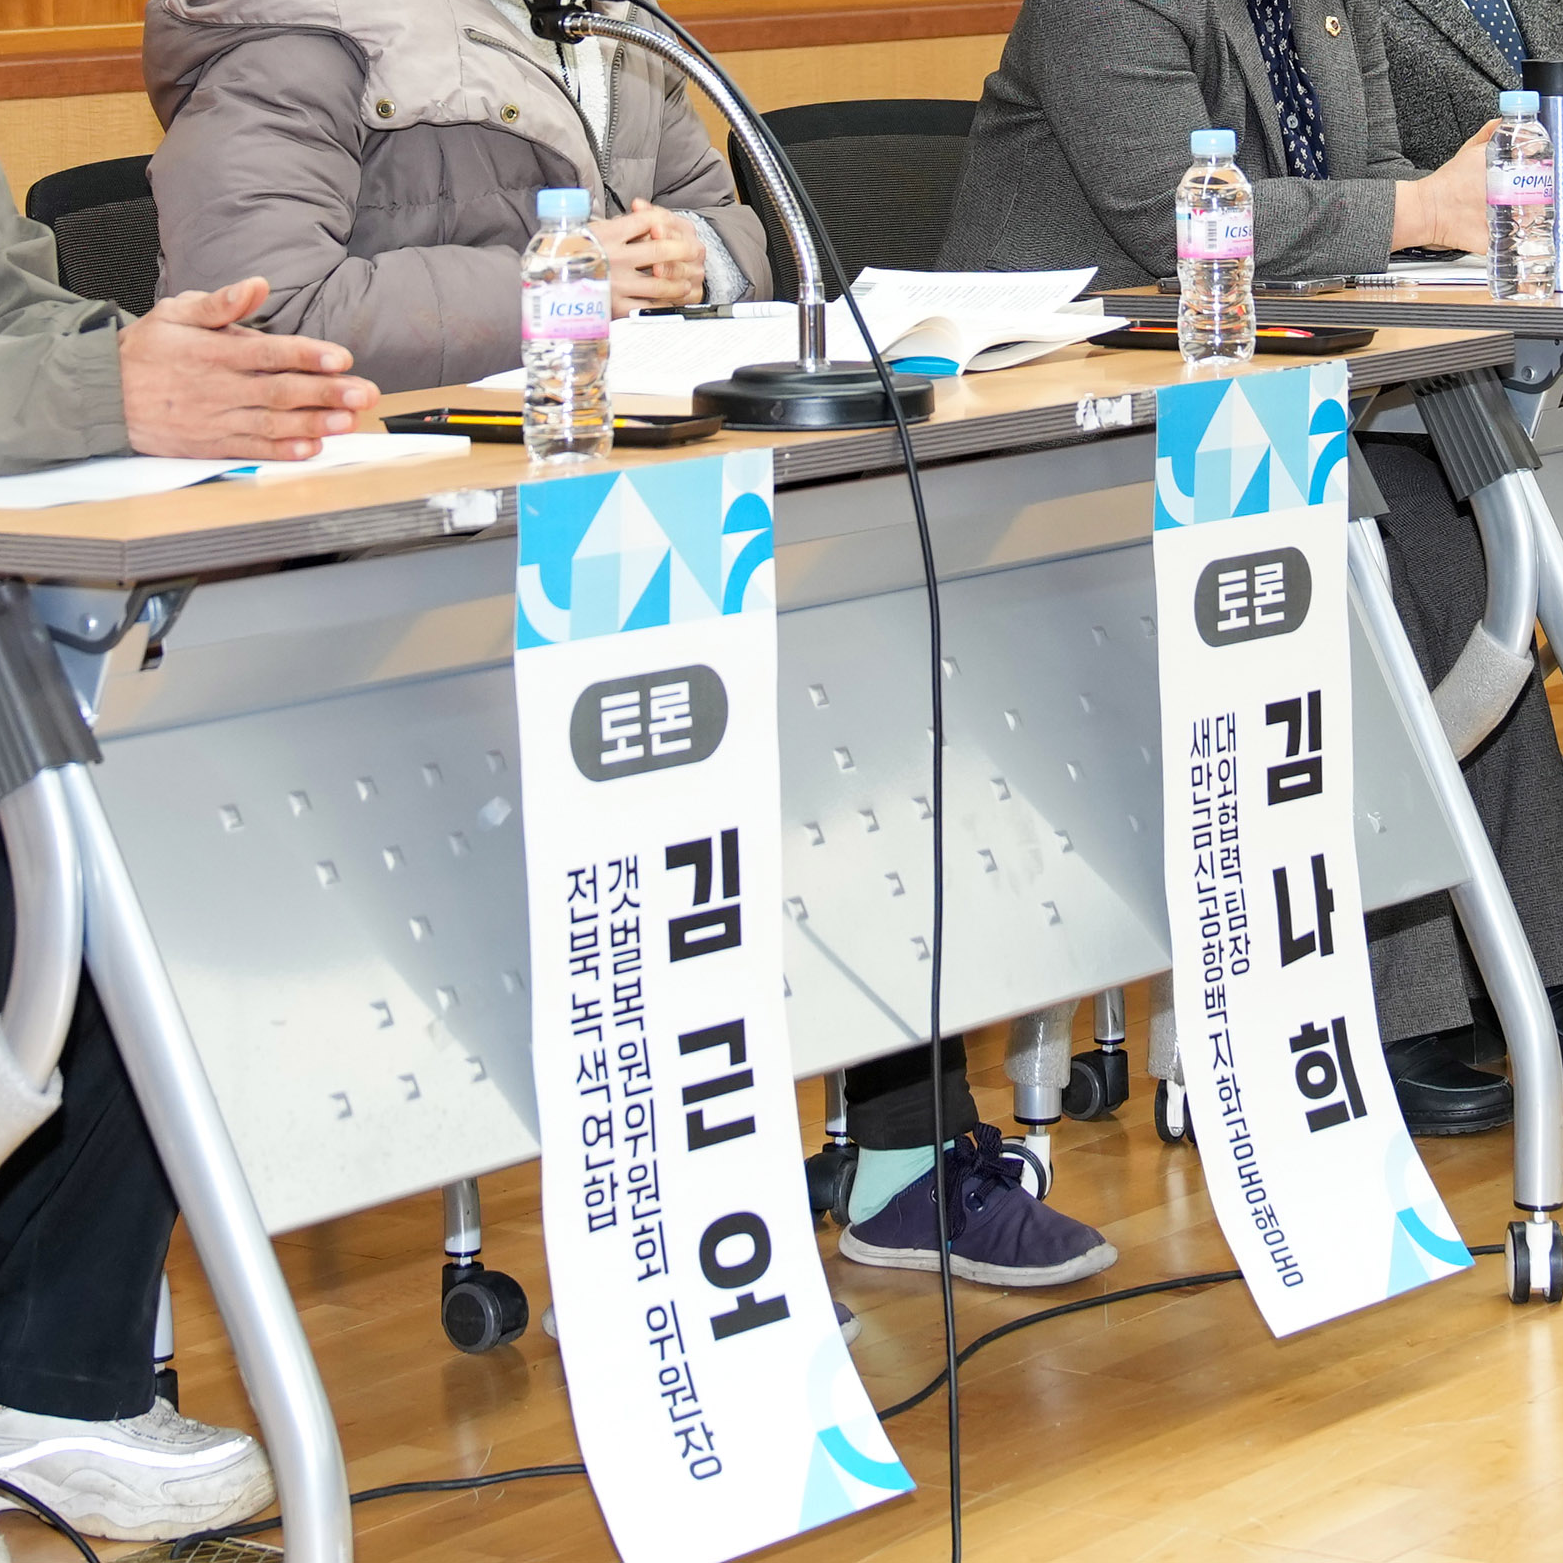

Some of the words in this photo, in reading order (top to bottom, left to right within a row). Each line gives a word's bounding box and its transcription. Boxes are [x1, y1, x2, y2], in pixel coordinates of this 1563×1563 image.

[598, 679, 695, 767] 토론
[1216, 560, 1287, 633] 토론
[1190, 716, 1305, 1288] 새만금신공항백지화공동행동
[1215, 711, 1251, 976] 대외협력팀장
[1264, 688, 1369, 1134] 김나희
[606, 854, 670, 1282] 갯벌복원위원회
[645, 1299, 723, 1481] 위원장
[664, 826, 792, 1342] 김근오
